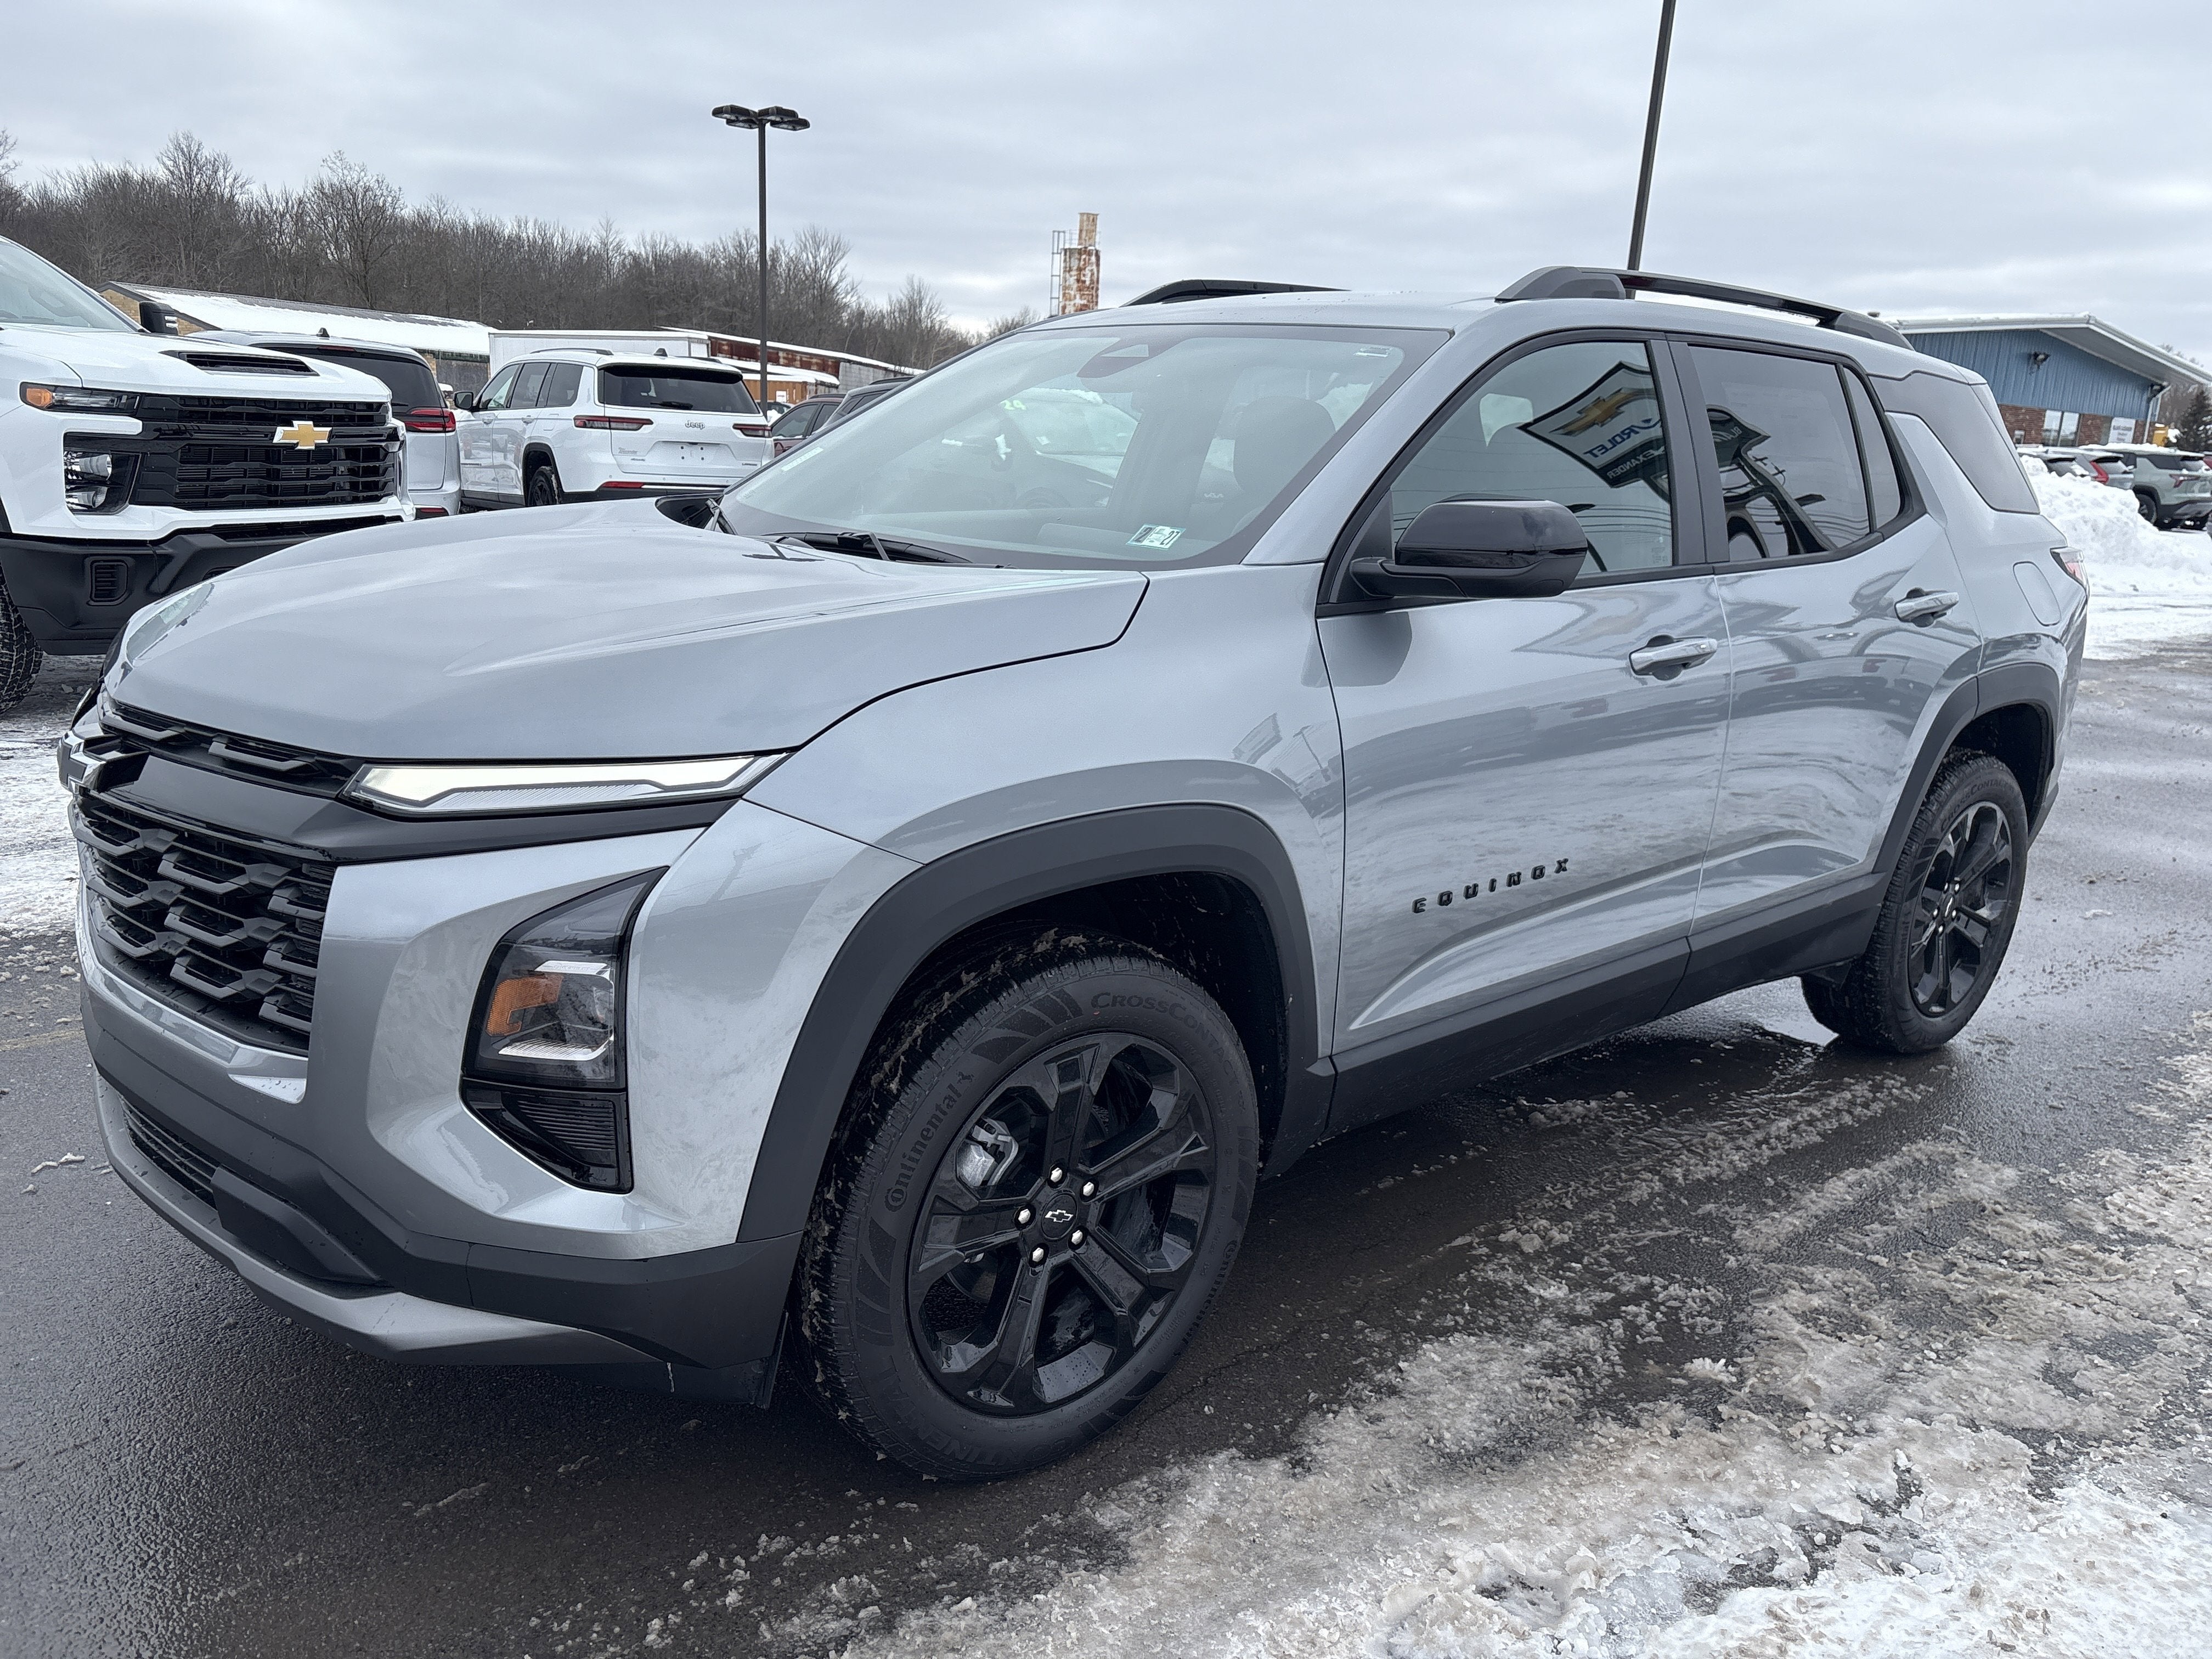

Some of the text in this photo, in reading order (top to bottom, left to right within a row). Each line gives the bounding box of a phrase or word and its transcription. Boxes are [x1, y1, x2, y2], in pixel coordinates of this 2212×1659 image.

[685, 420, 706, 430] Jeep
[1134, 527, 1181, 546] 2 27
[1412, 858, 1568, 913] EQUINOX
[884, 1083, 962, 1212] Continental
